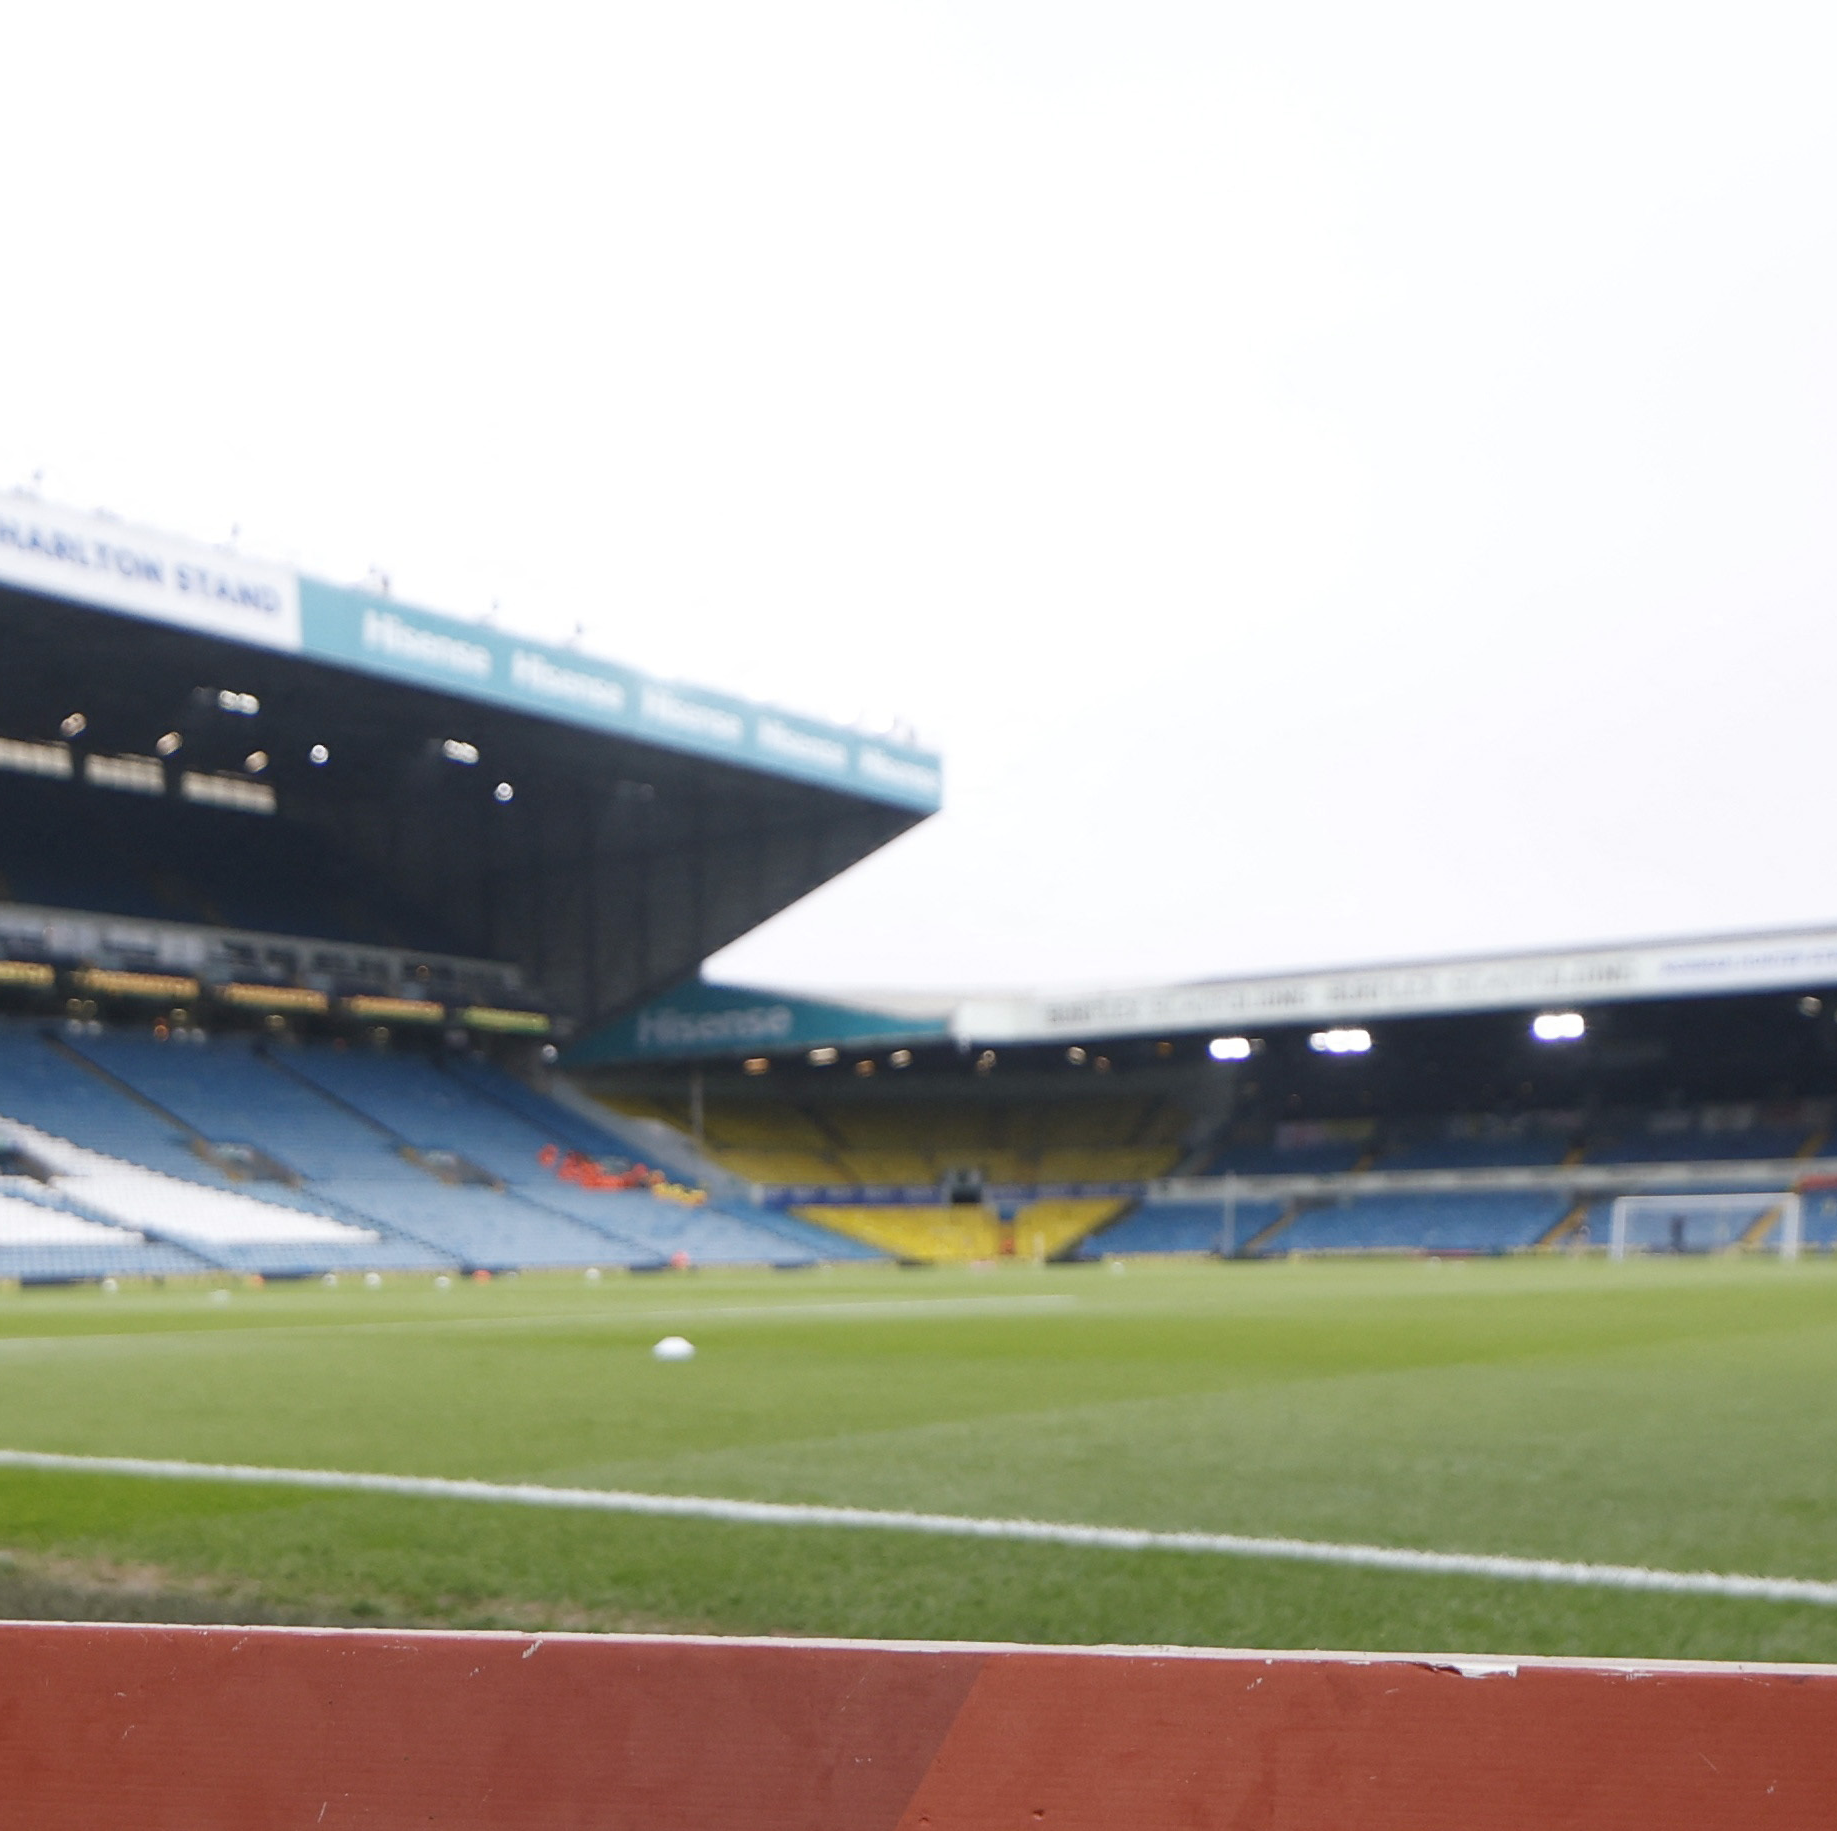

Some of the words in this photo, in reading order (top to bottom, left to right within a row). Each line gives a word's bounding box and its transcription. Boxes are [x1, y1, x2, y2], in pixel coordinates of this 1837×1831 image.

[177, 566, 281, 612] STAND
[365, 609, 491, 680] Hisense
[512, 648, 624, 713] Hisense
[637, 1004, 794, 1048] Hisense
